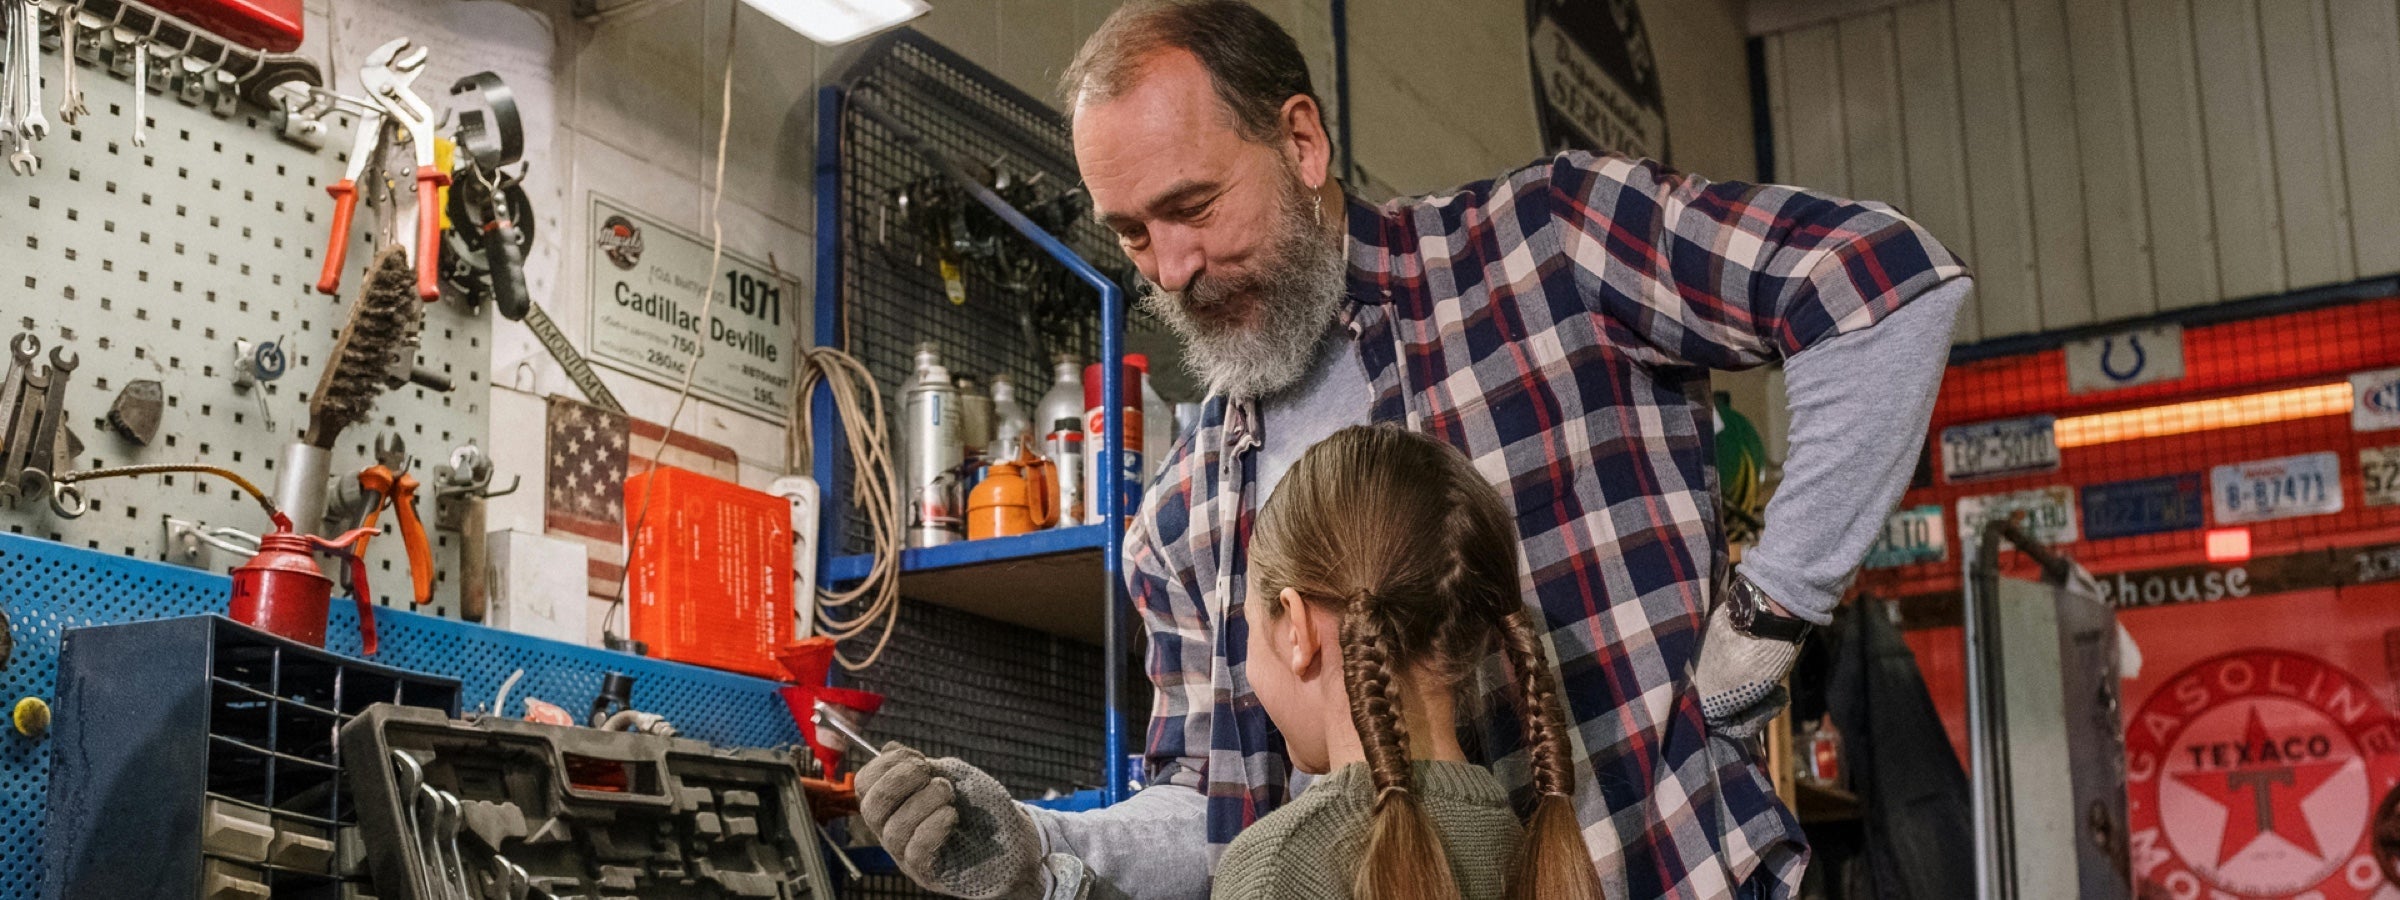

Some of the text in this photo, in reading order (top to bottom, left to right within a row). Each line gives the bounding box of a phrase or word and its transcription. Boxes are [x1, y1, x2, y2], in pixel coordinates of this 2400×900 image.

[615, 281, 702, 336] Cadillac
[710, 316, 778, 363] Deville
[726, 269, 781, 326] 1971
[231, 578, 250, 598] IL
[2128, 660, 2393, 783] GASOLINE
[2187, 733, 2332, 768] TEXACO
